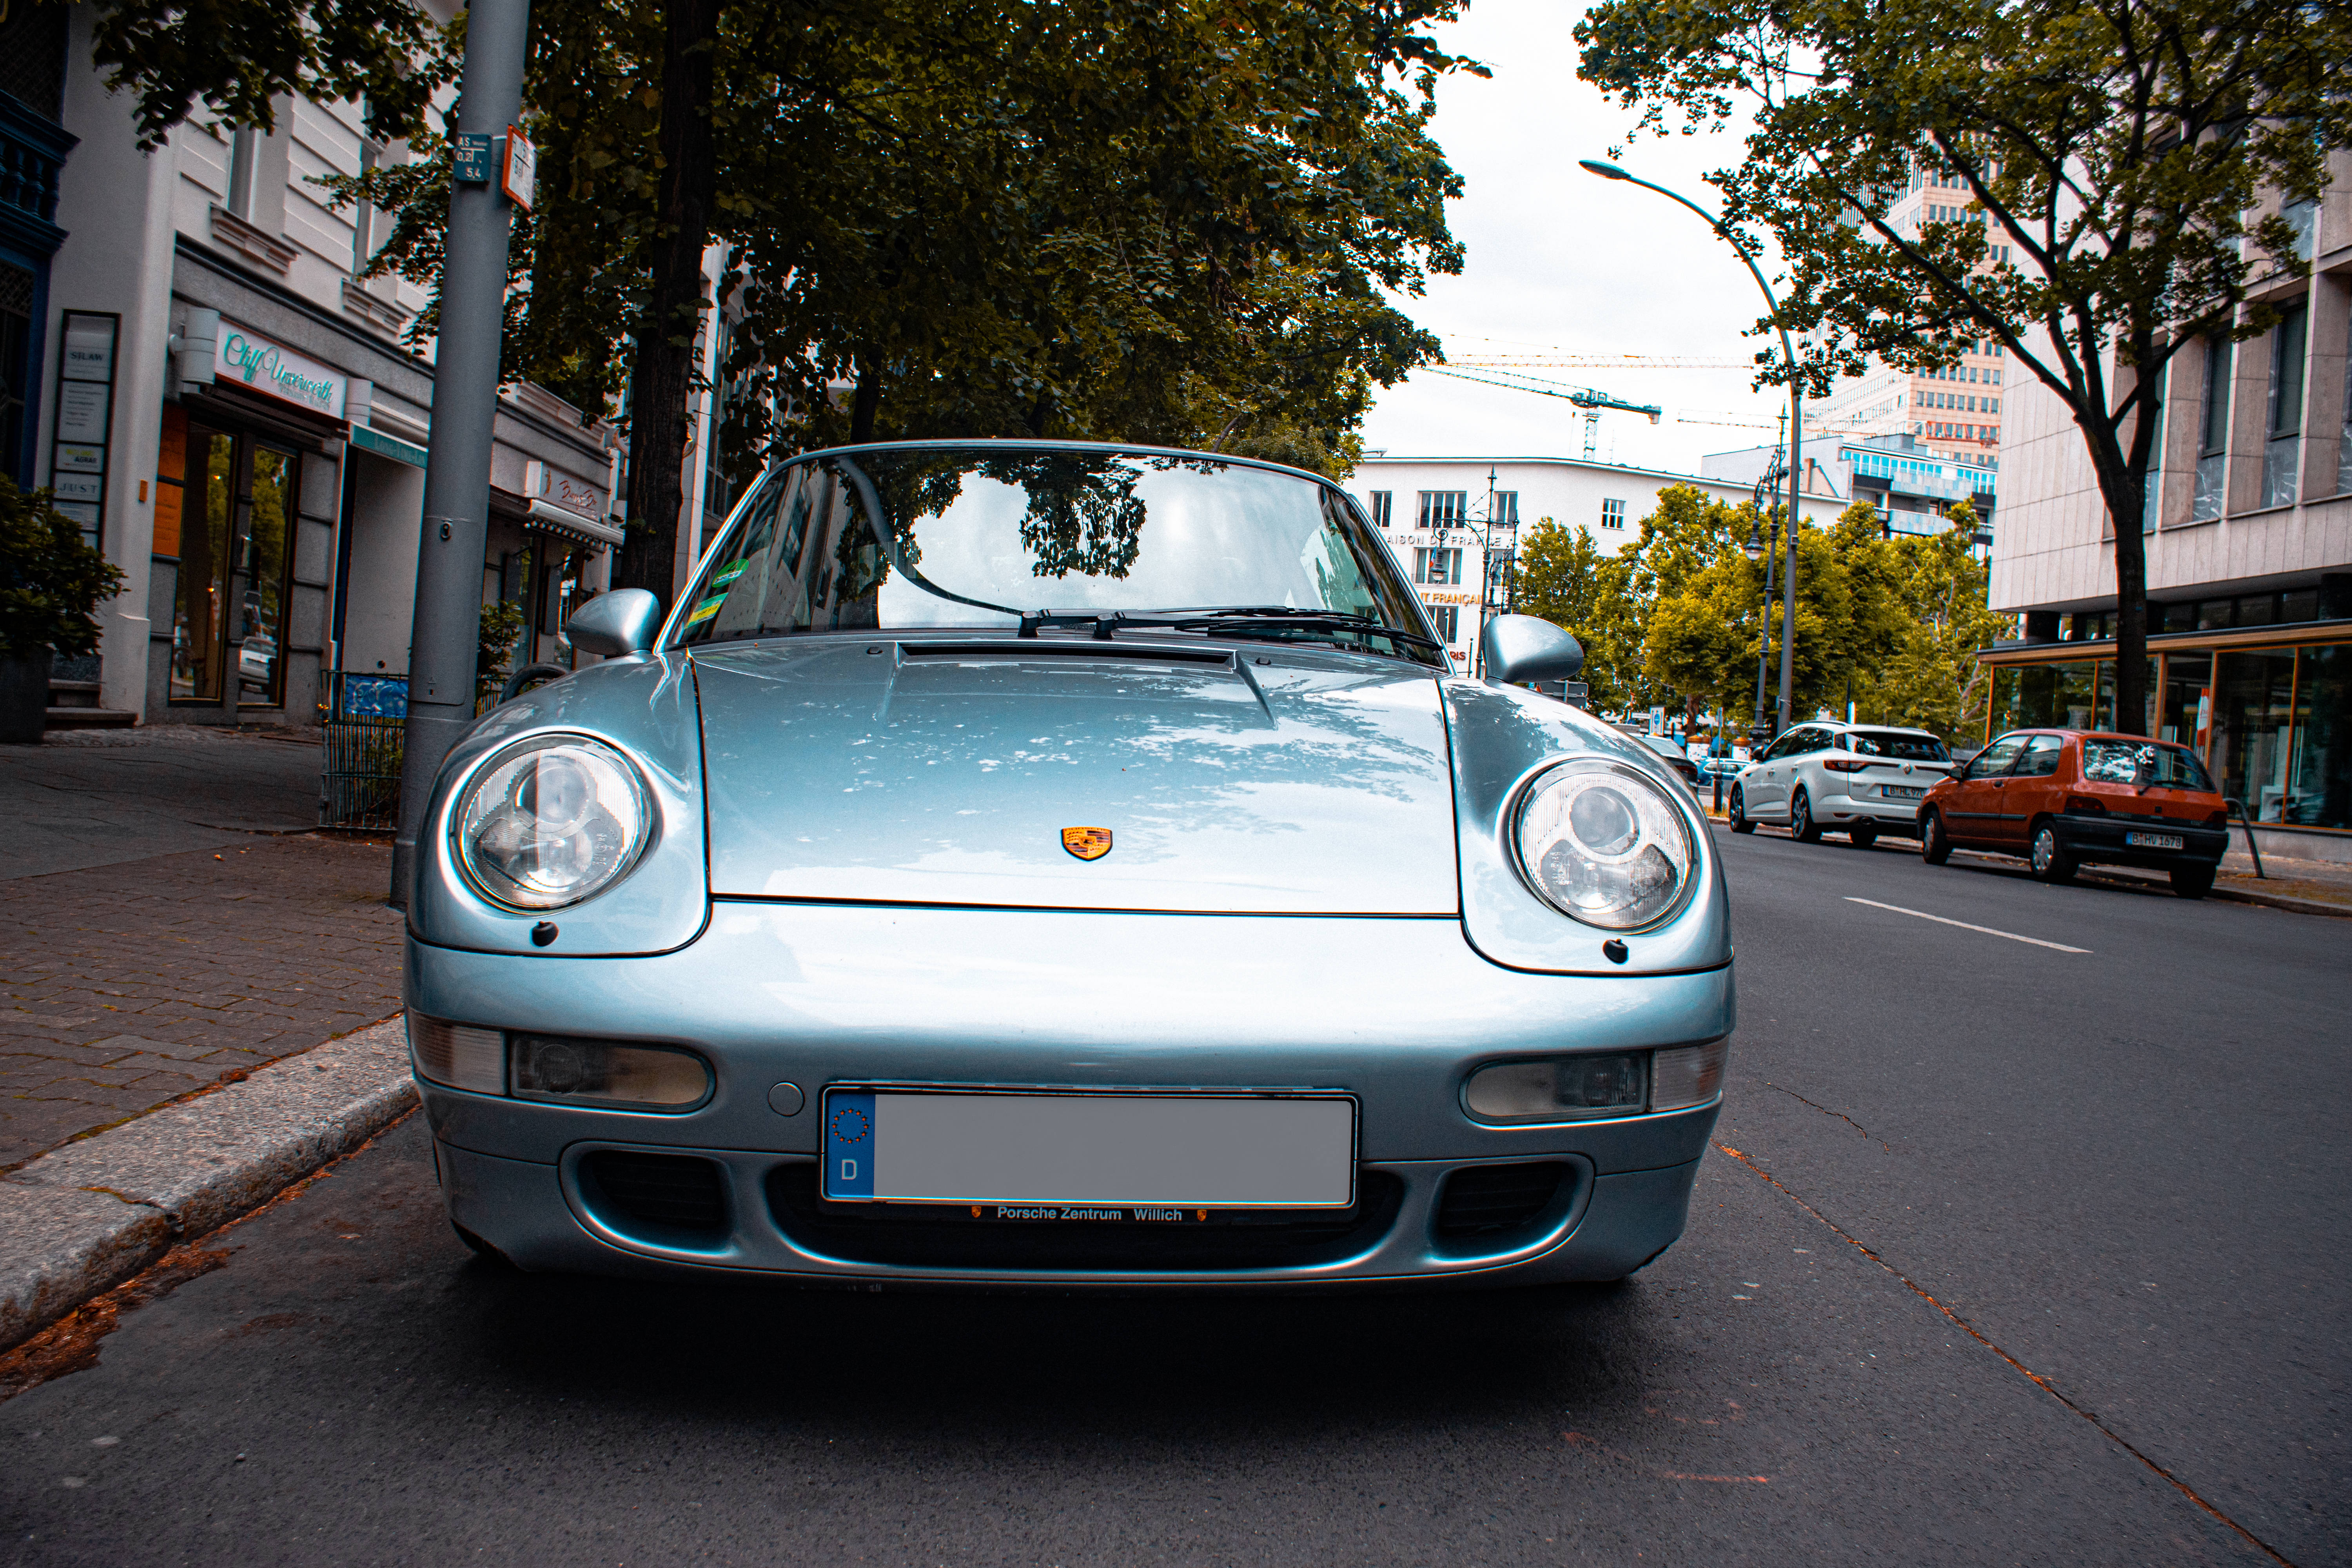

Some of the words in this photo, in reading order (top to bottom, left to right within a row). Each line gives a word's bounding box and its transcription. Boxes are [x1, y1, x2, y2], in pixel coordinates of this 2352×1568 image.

[457, 136, 470, 147] AS
[466, 166, 481, 179] 5,4
[60, 483, 97, 493] JUST
[1449, 651, 1466, 661] RIS
[2132, 833, 2138, 844] B
[2144, 834, 2157, 845] HV
[2158, 835, 2181, 848] 1678
[841, 1158, 858, 1180] D
[997, 1206, 1056, 1219] Porsche
[1060, 1207, 1122, 1220] Zentrum
[1134, 1209, 1182, 1221] Willich
